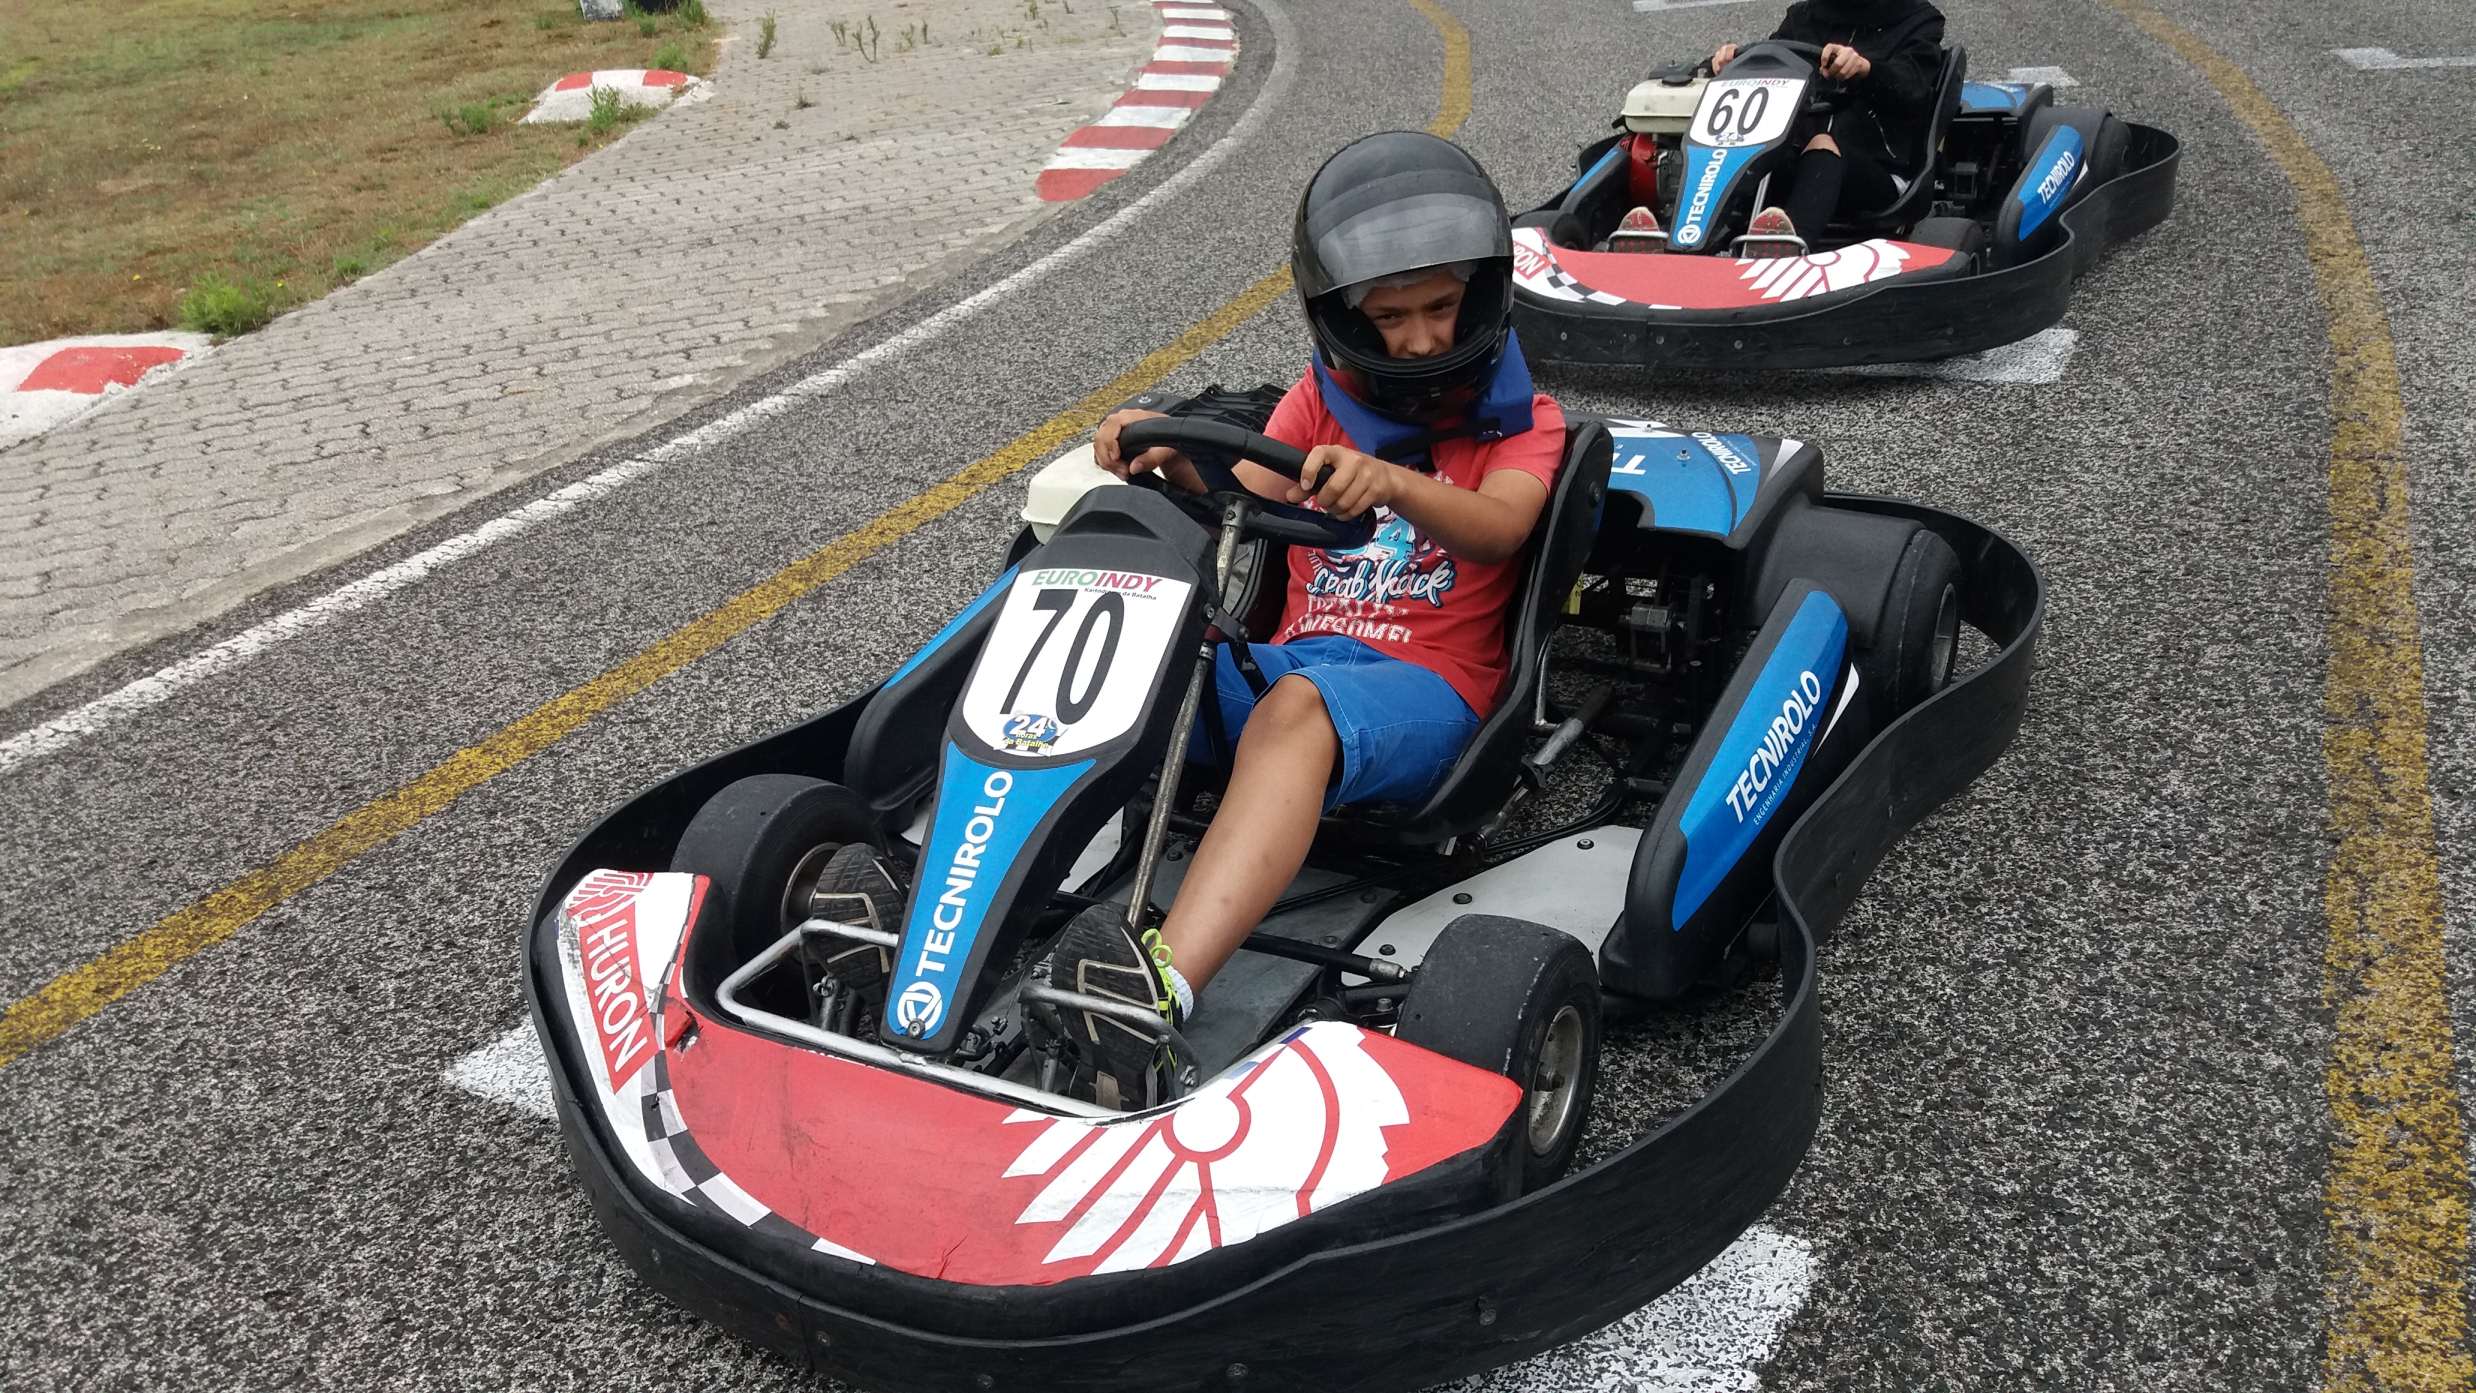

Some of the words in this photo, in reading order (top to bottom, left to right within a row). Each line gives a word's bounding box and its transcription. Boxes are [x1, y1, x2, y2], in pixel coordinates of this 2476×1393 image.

[1707, 86, 1769, 136] 60
[1686, 148, 1728, 224] TECNIROLO
[2037, 151, 2075, 205] TECNIROLO
[1691, 431, 1752, 474] TECNIROLO
[1031, 569, 1163, 593] EUROINDY
[1000, 588, 1125, 726] 70
[1008, 714, 1049, 737] 24
[1725, 670, 1821, 823] TECNIROLO
[915, 770, 1013, 977] TECNIROLO
[586, 918, 649, 1073] HURON
